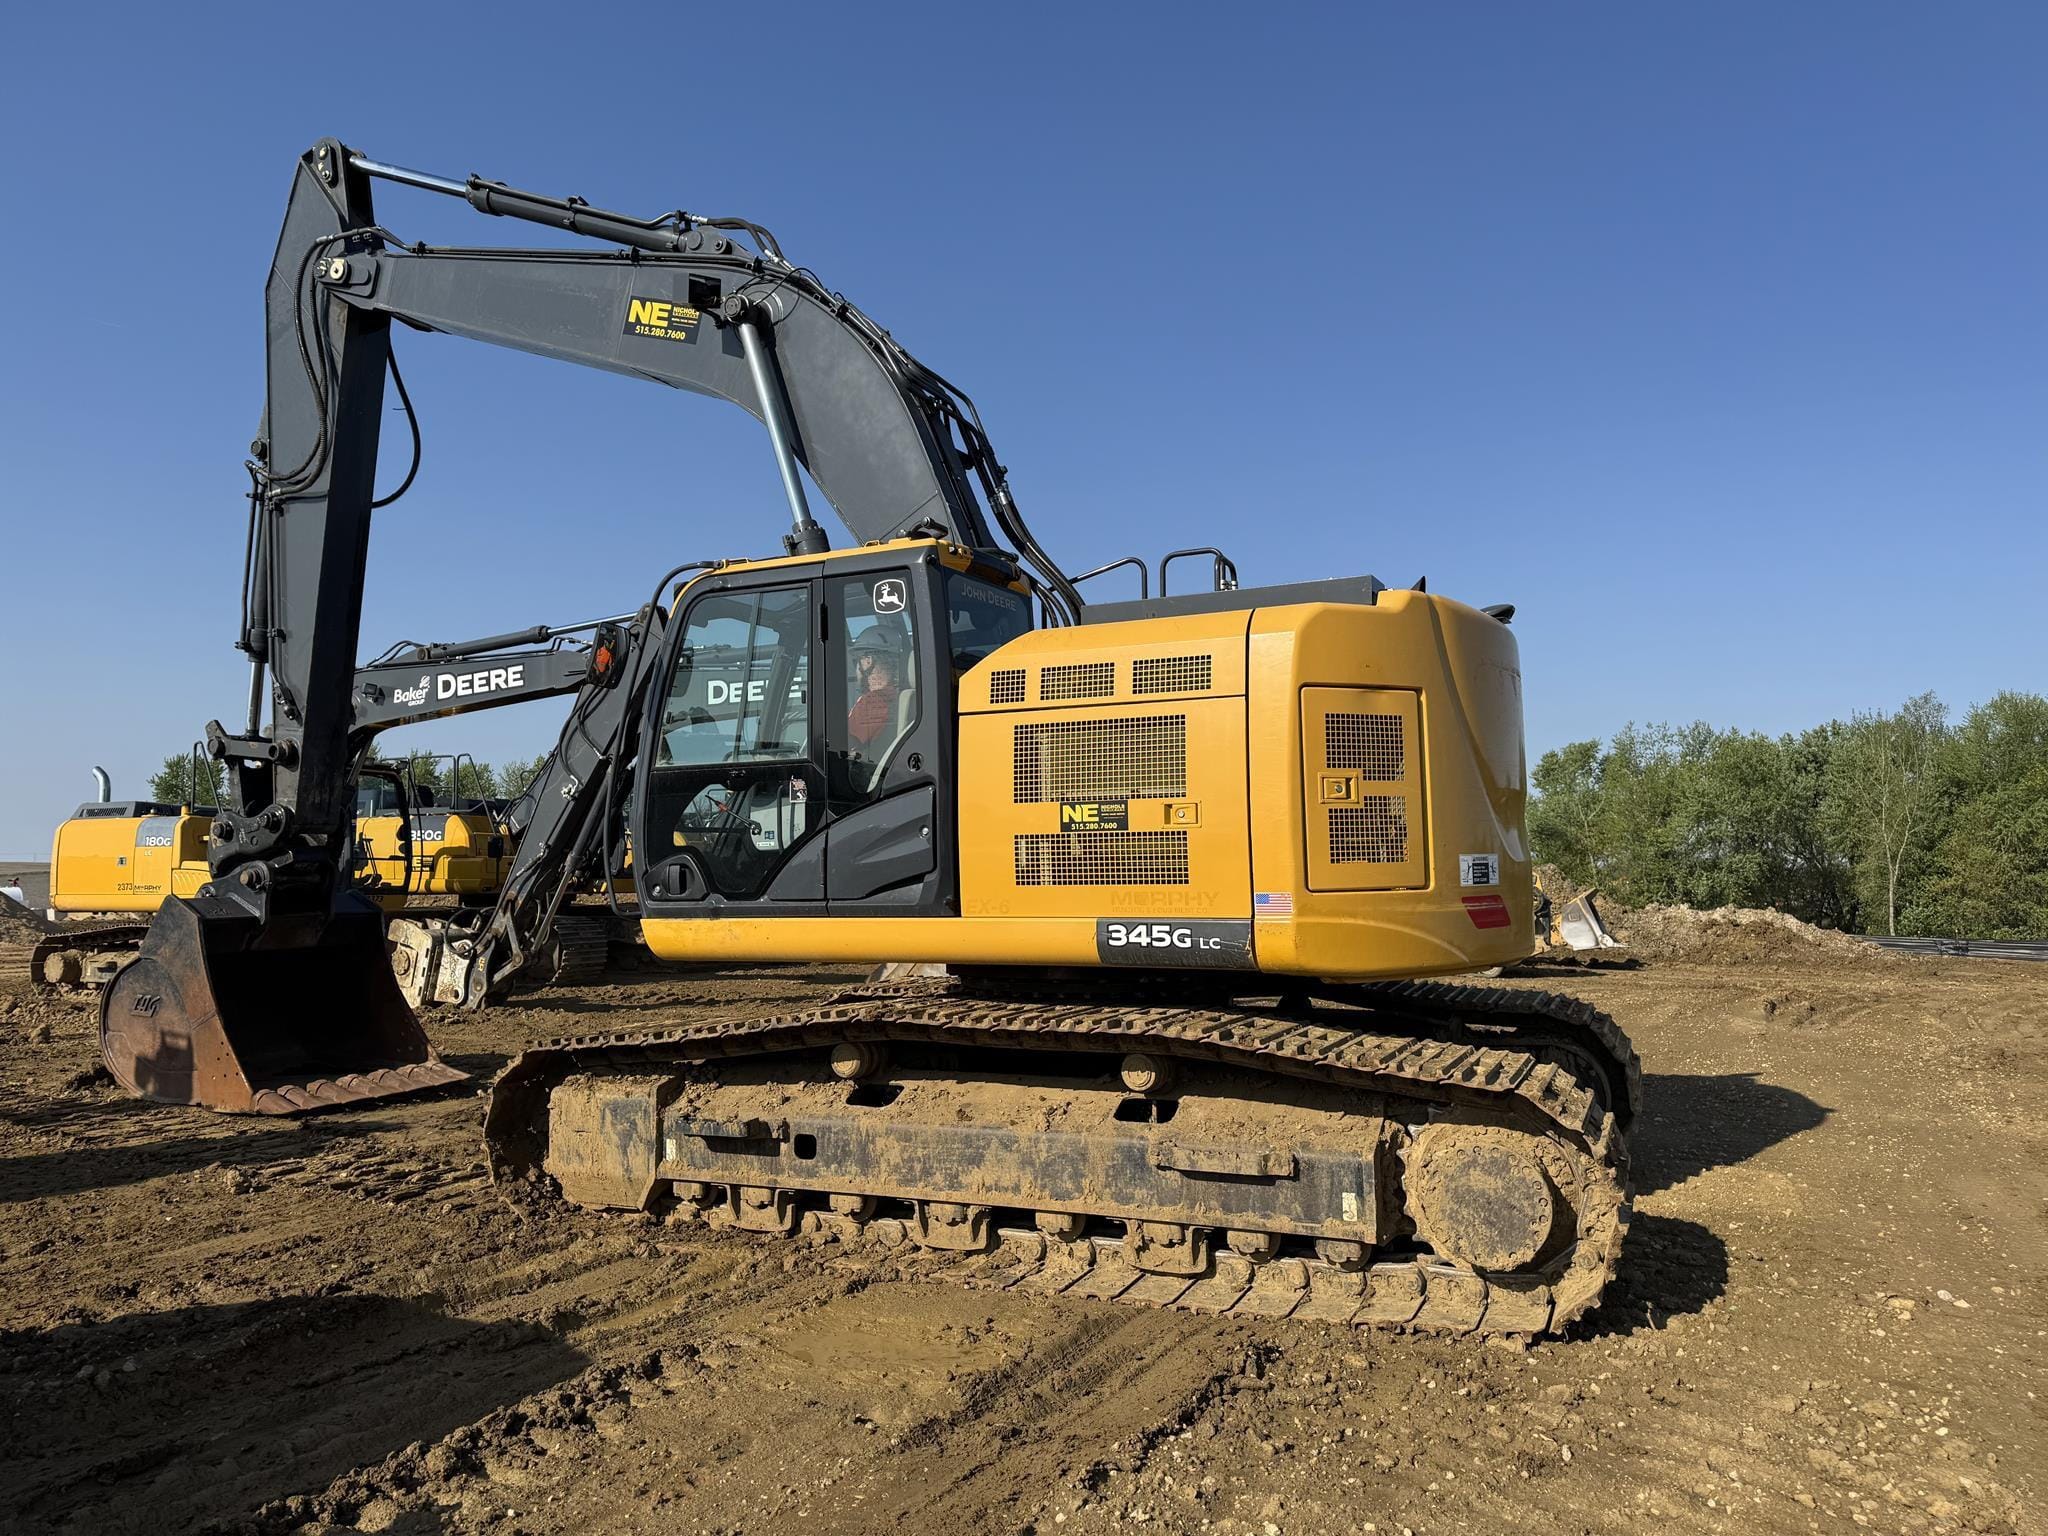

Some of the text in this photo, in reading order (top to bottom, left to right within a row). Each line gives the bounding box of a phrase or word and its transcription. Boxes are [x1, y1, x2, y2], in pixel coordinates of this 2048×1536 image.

[628, 299, 672, 327] NE
[635, 325, 686, 340] 515.280.7600
[961, 583, 1017, 612] JOHN DEERE
[437, 665, 524, 700] DEERE
[707, 676, 802, 705] DEEE
[393, 687, 429, 703] Baker
[1062, 803, 1099, 823] NE
[1071, 822, 1118, 831] 515.280.7600
[145, 836, 171, 847] 180G
[117, 882, 133, 891] 2373
[1107, 924, 1221, 950] 345G LC
